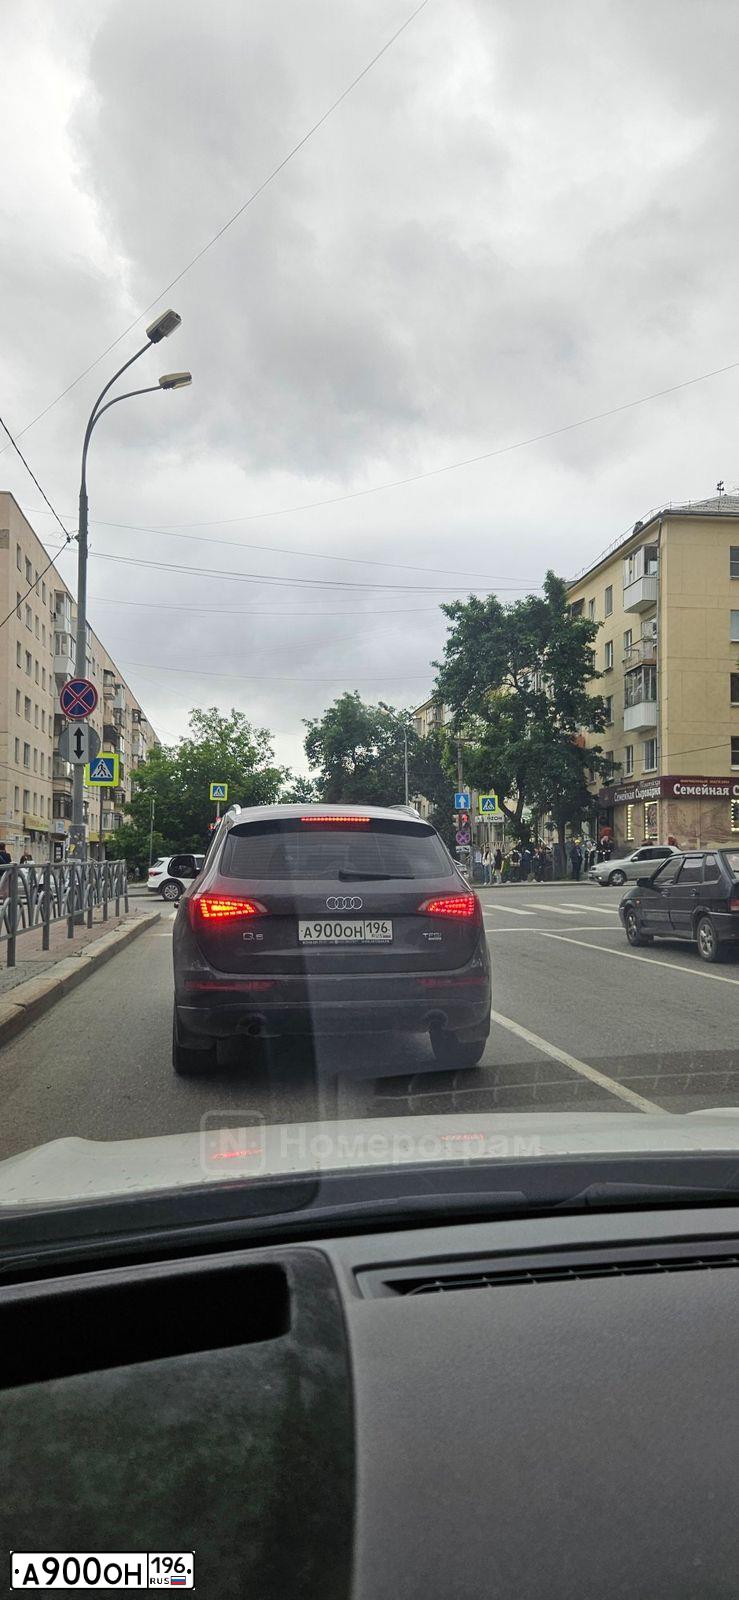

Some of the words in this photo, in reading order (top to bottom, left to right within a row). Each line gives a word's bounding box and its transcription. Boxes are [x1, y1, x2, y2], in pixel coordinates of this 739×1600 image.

[673, 783, 729, 796] Семейная
[303, 923, 363, 938] А900ОН
[366, 922, 388, 934] 196
